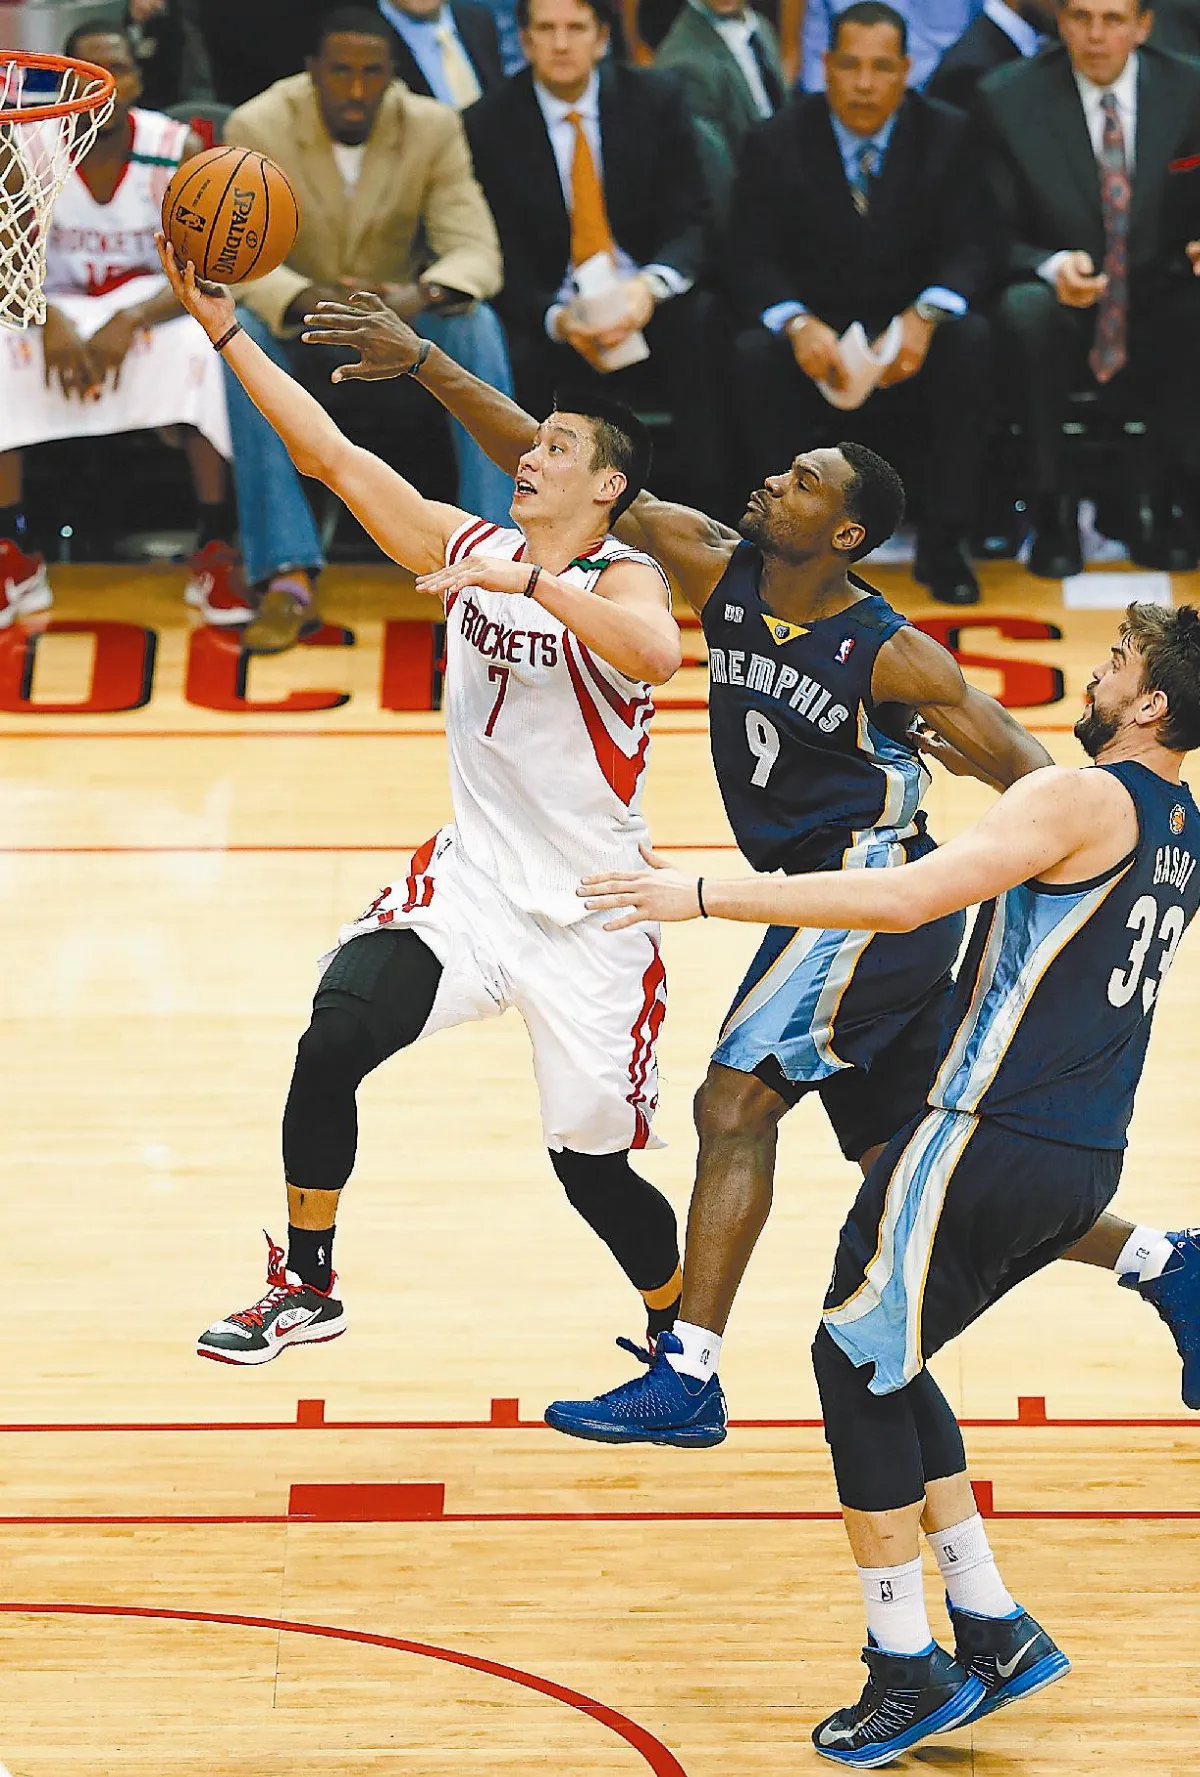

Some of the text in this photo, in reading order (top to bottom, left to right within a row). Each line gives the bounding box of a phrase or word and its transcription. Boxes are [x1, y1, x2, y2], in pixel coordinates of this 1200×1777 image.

[212, 188, 256, 275] SPALDING
[460, 596, 558, 667] ROCKETS
[484, 663, 511, 737] 7
[709, 648, 850, 733] MEMPHIS
[744, 709, 781, 788] 9
[1107, 895, 1185, 1017] 33
